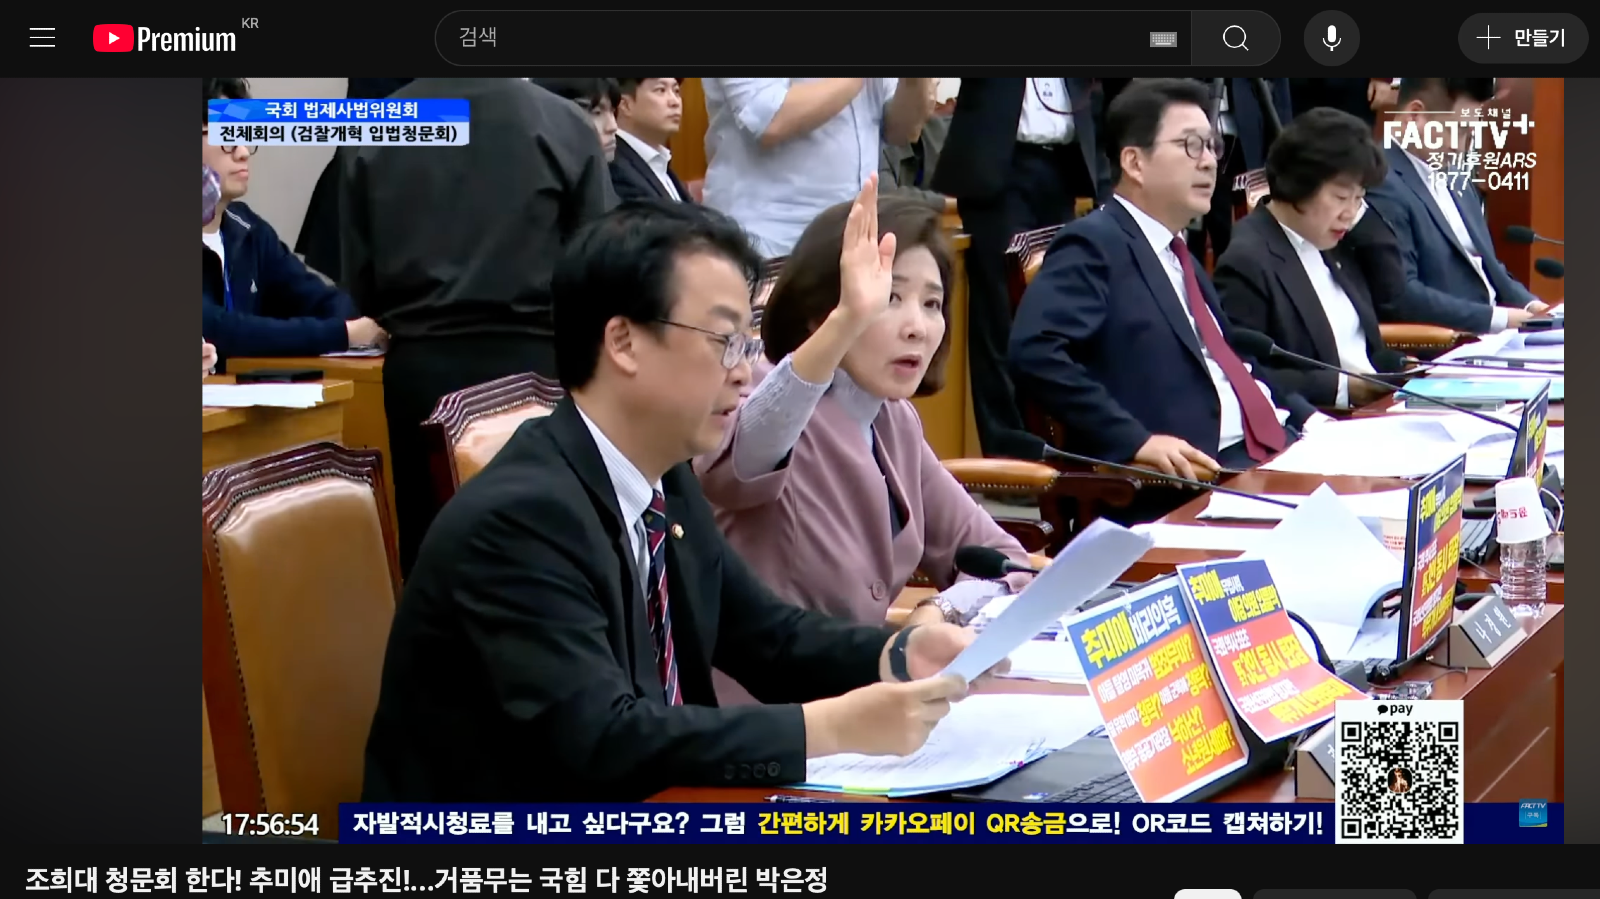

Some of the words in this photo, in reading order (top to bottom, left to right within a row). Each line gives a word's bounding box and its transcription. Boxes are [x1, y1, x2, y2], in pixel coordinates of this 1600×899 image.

[241, 17, 259, 29] KR
[137, 26, 236, 52] Premium
[459, 26, 497, 48] 검색
[1514, 27, 1565, 48] 만들기
[1188, 569, 1224, 606] 추미애
[1080, 611, 1134, 668] 추미애
[1130, 594, 1182, 645] 비리의혹
[25, 866, 98, 894] 조희대
[105, 866, 177, 894] 청문회
[185, 866, 242, 894] 한다!
[249, 866, 321, 894] 추미애
[539, 866, 587, 894] 국힘
[596, 866, 621, 894] 다
[626, 866, 748, 894] 쫓아내버린
[756, 866, 827, 894] 박은정
